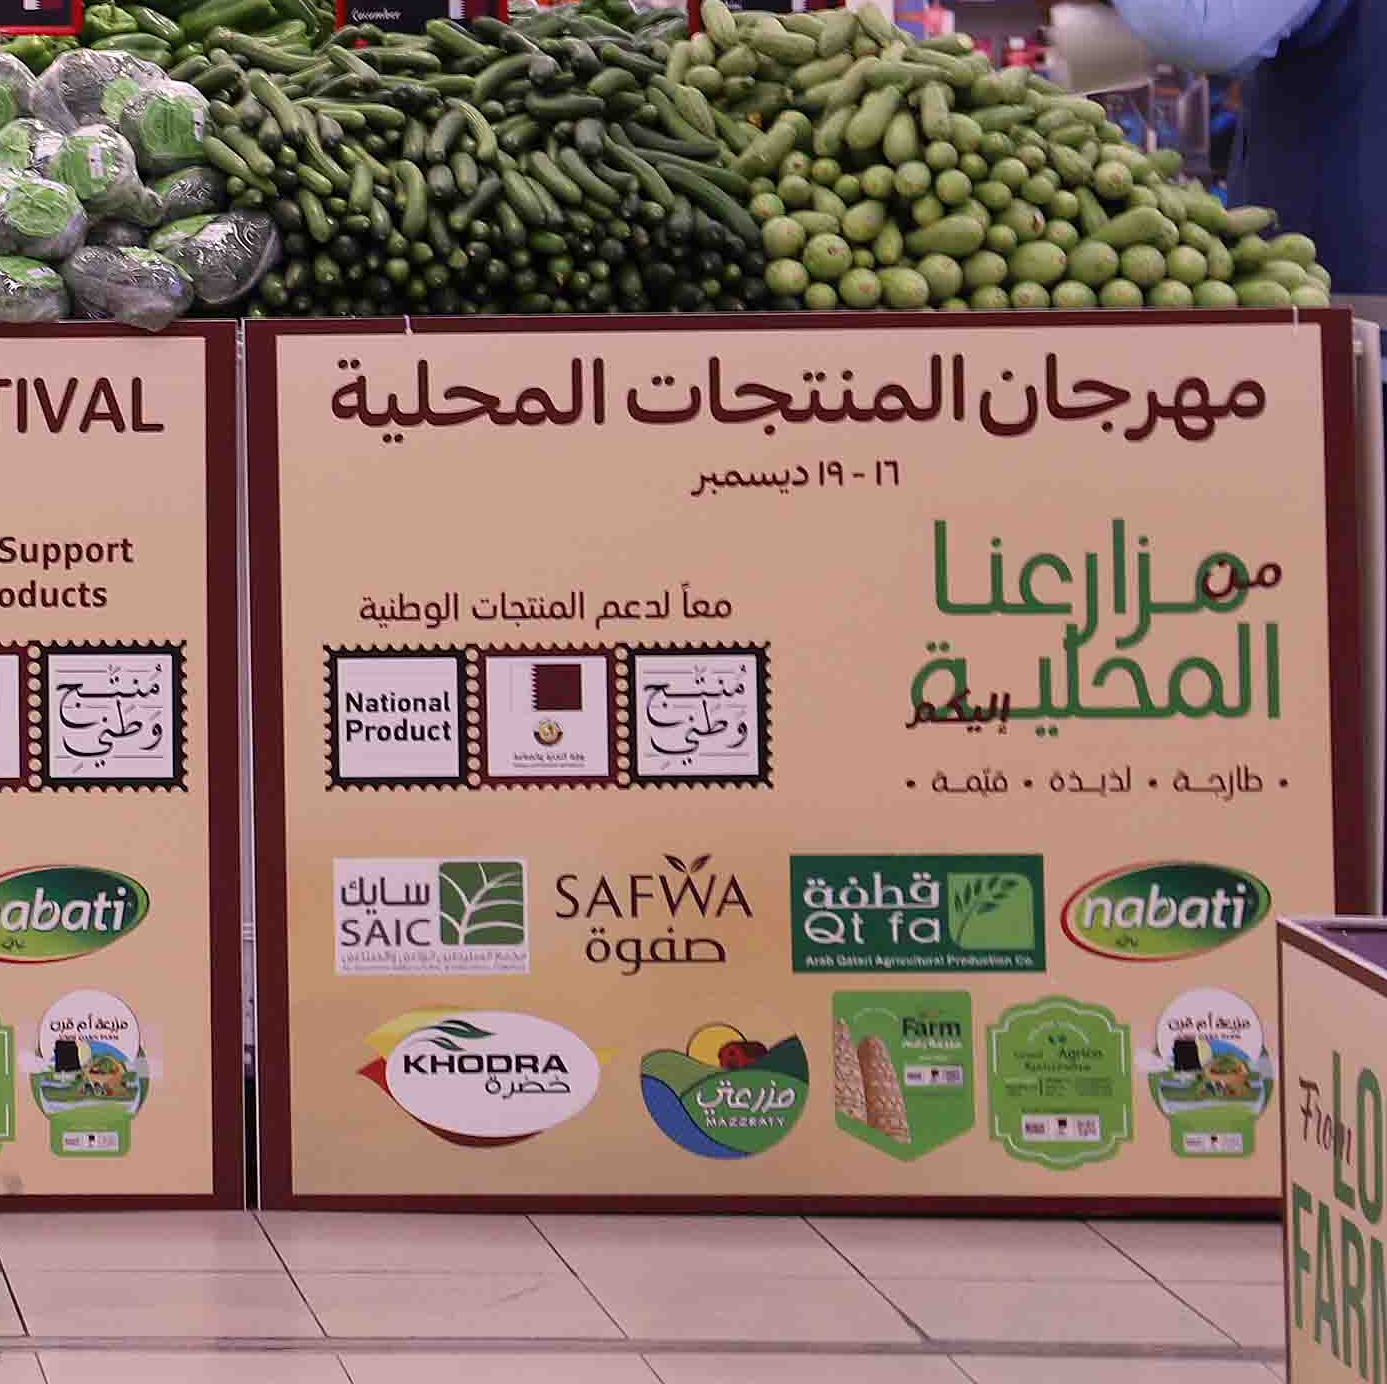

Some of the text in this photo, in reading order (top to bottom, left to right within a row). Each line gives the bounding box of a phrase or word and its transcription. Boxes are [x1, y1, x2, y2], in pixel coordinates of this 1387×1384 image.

[332, 352, 1265, 443] مهرجان المنتجات المحلية
[0, 537, 133, 570] Support
[555, 873, 754, 919] SAFWA
[404, 1055, 568, 1074] KHODRA
